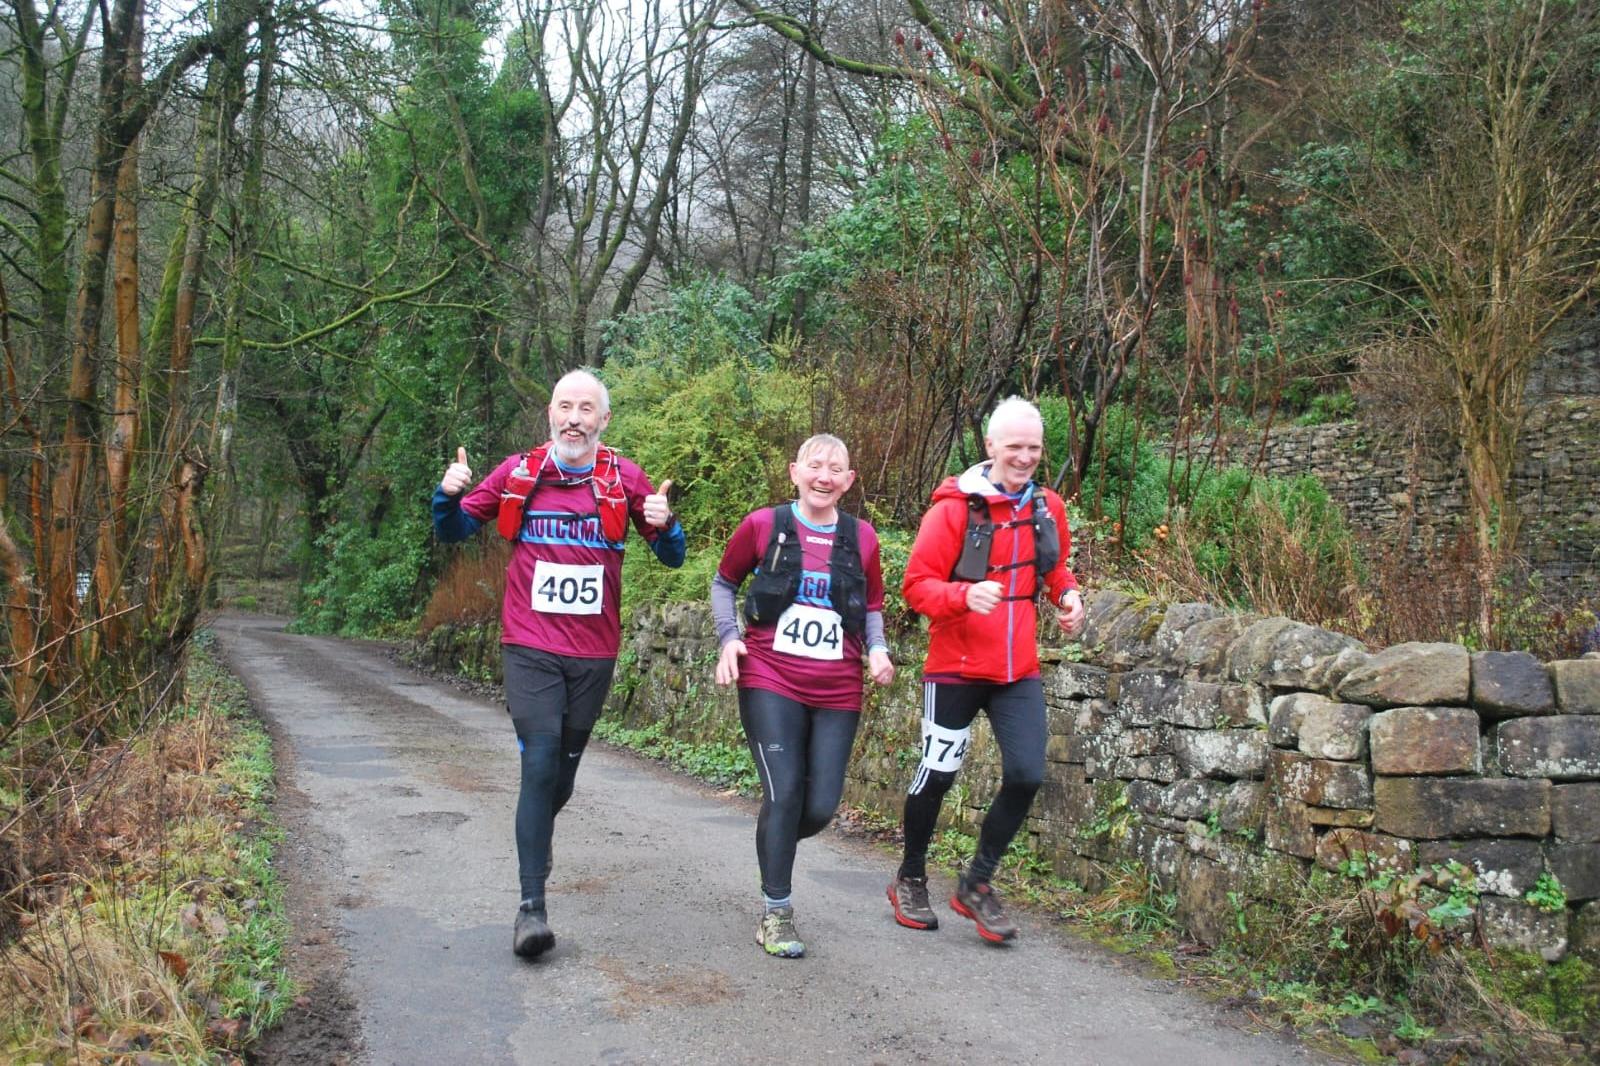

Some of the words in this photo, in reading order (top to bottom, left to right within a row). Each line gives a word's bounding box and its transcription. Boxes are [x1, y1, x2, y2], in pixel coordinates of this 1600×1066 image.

[538, 577, 598, 604] 405
[782, 617, 839, 649] 404
[924, 734, 967, 762] 174
